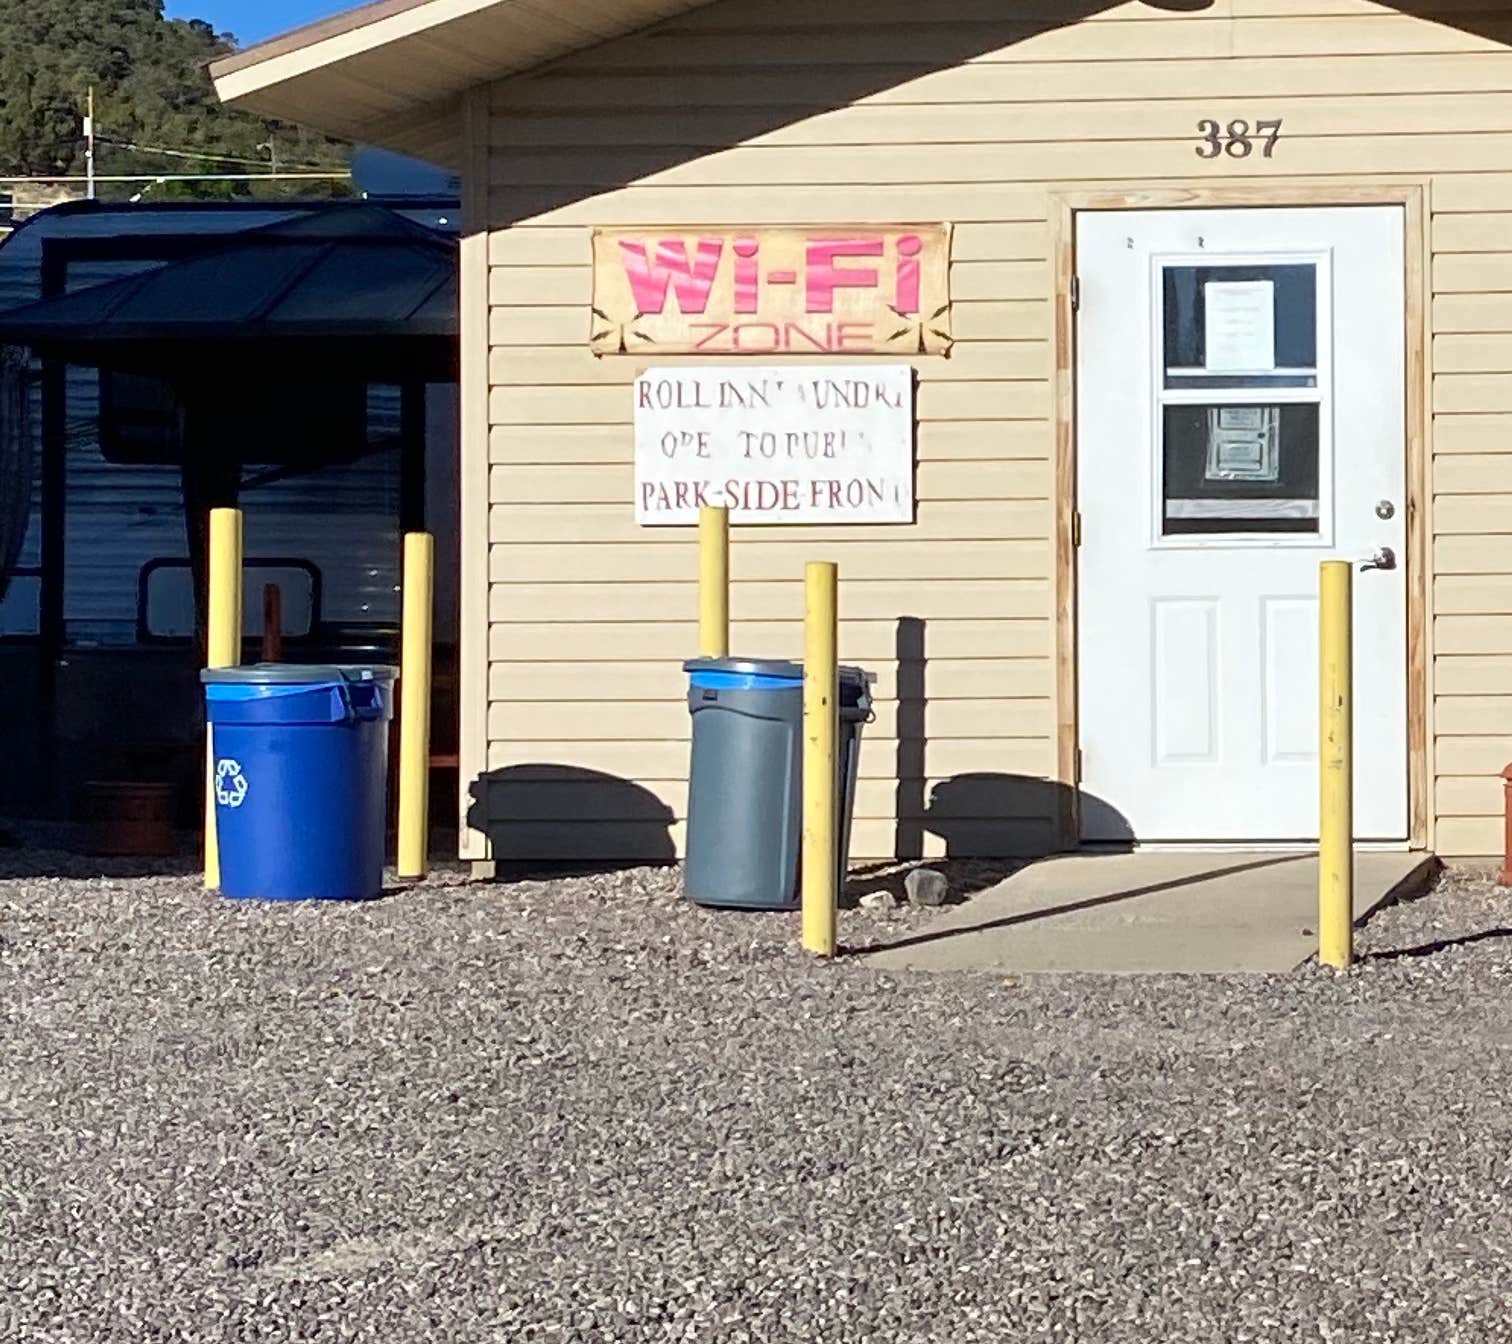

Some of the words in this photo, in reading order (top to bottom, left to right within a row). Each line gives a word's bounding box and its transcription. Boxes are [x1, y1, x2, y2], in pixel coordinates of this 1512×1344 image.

[1195, 118, 1284, 159] 387
[617, 234, 924, 315] Wi-Fi
[688, 321, 876, 352] ZONE
[638, 379, 711, 410] ROLL
[737, 430, 777, 459] TO
